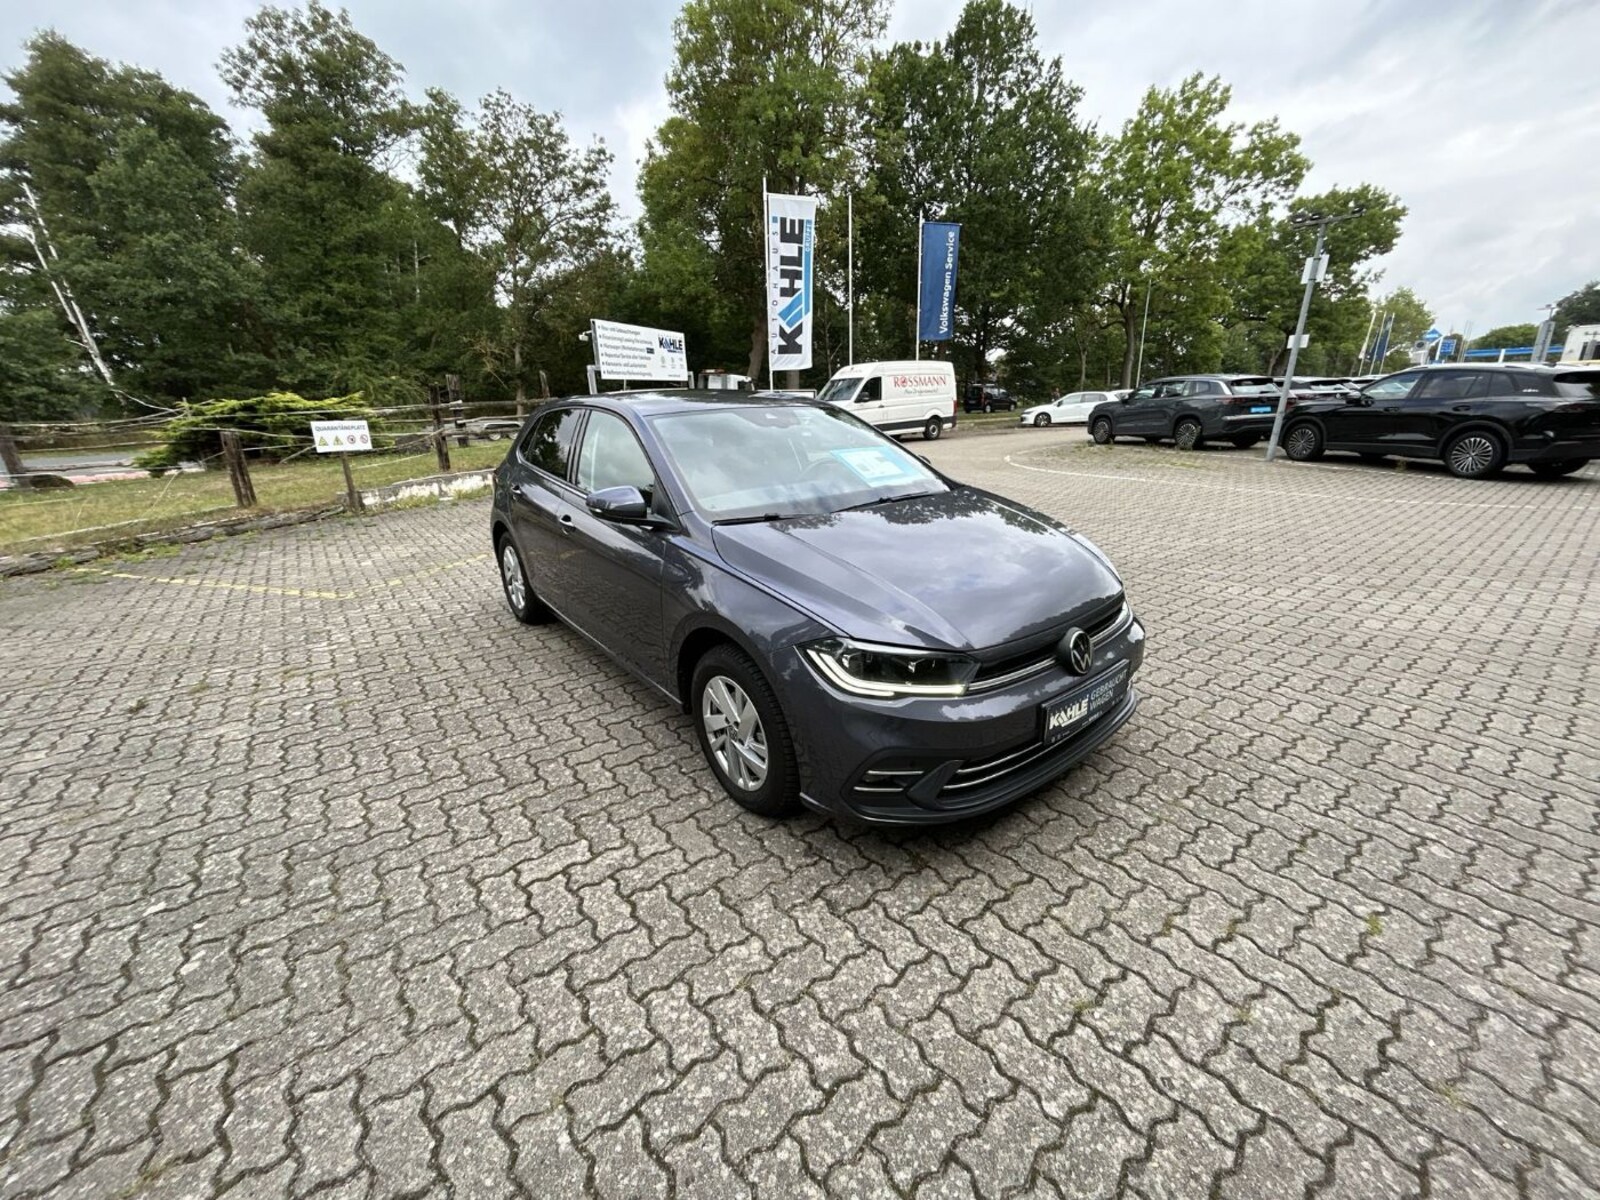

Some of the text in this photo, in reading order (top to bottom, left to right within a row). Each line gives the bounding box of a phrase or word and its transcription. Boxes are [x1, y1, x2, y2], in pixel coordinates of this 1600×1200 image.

[771, 231, 779, 355] AUTOHAUS
[939, 231, 955, 334] Volkswagen Service
[893, 374, 947, 388] ROSSMANN
[1089, 688, 1114, 711] WAGEN
